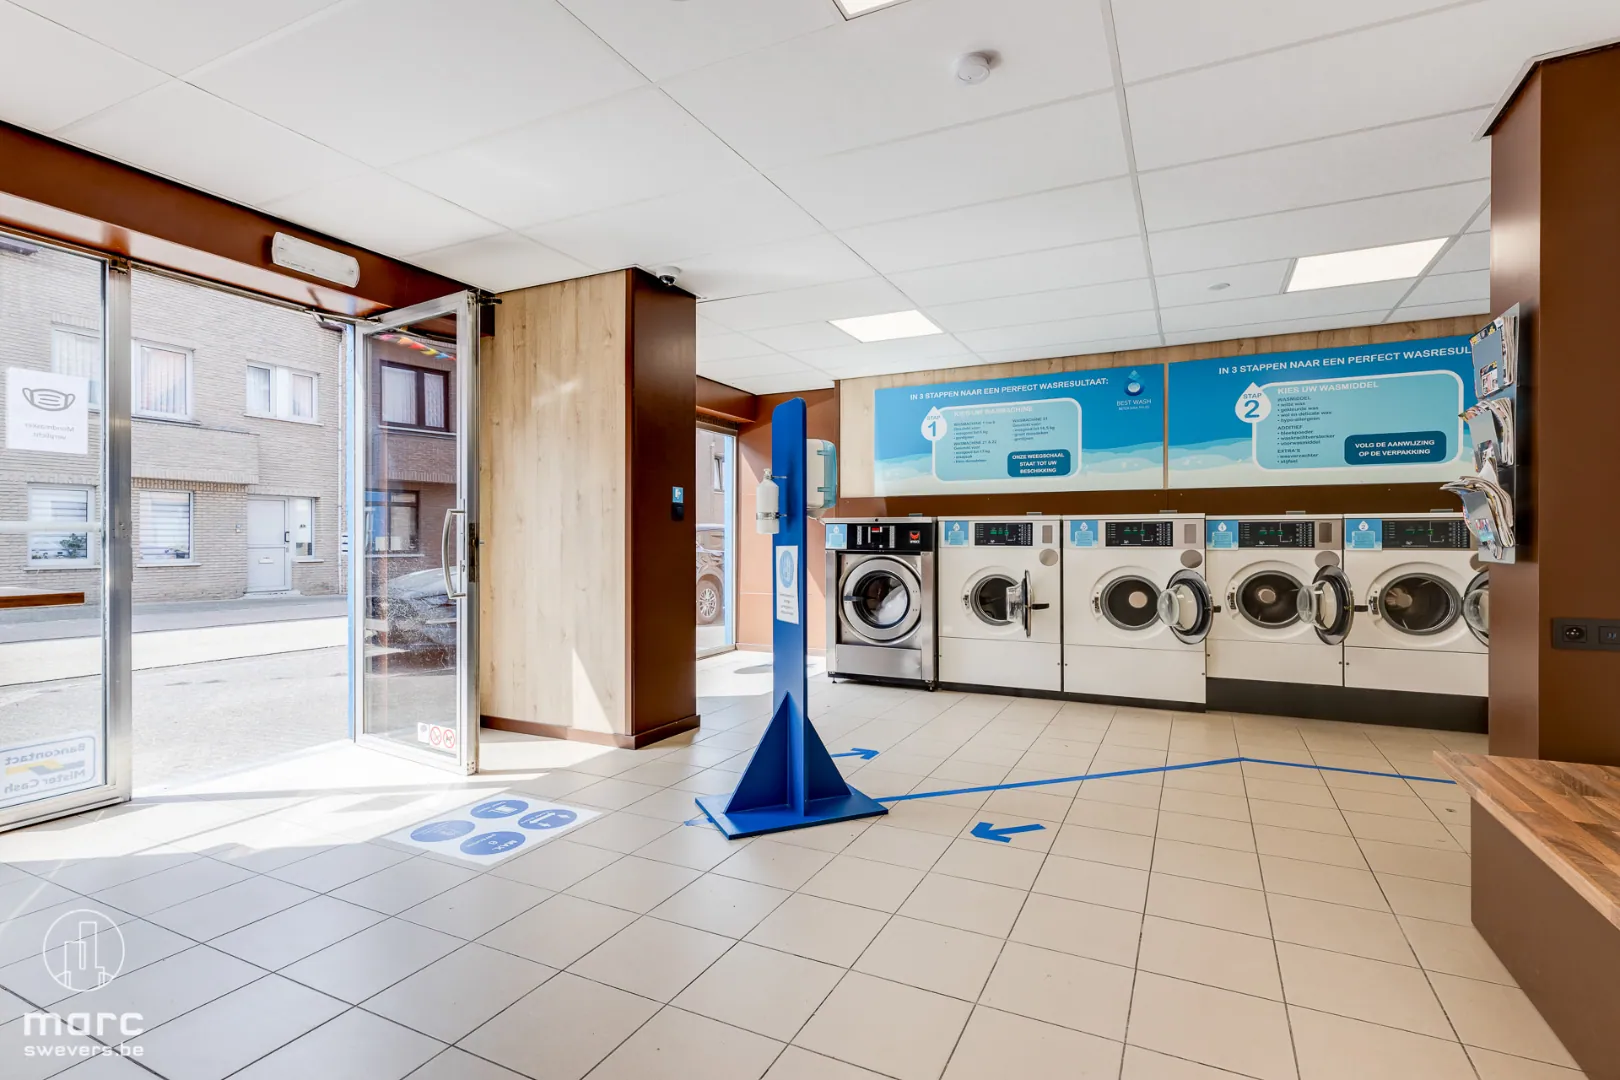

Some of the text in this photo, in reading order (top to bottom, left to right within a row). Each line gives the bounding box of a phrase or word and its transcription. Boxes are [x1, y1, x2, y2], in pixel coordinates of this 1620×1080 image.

[1240, 362, 1286, 373] STAPPEN
[1290, 359, 1320, 369] NAAR
[1323, 357, 1345, 366] EEN
[1348, 353, 1400, 364] PERFECT
[1002, 384, 1037, 392] PERFECT
[1040, 378, 1108, 390] WASRESULTAAT:
[1320, 382, 1378, 391] WASMIDDEL
[1244, 400, 1260, 418] 2
[928, 421, 936, 437] 1
